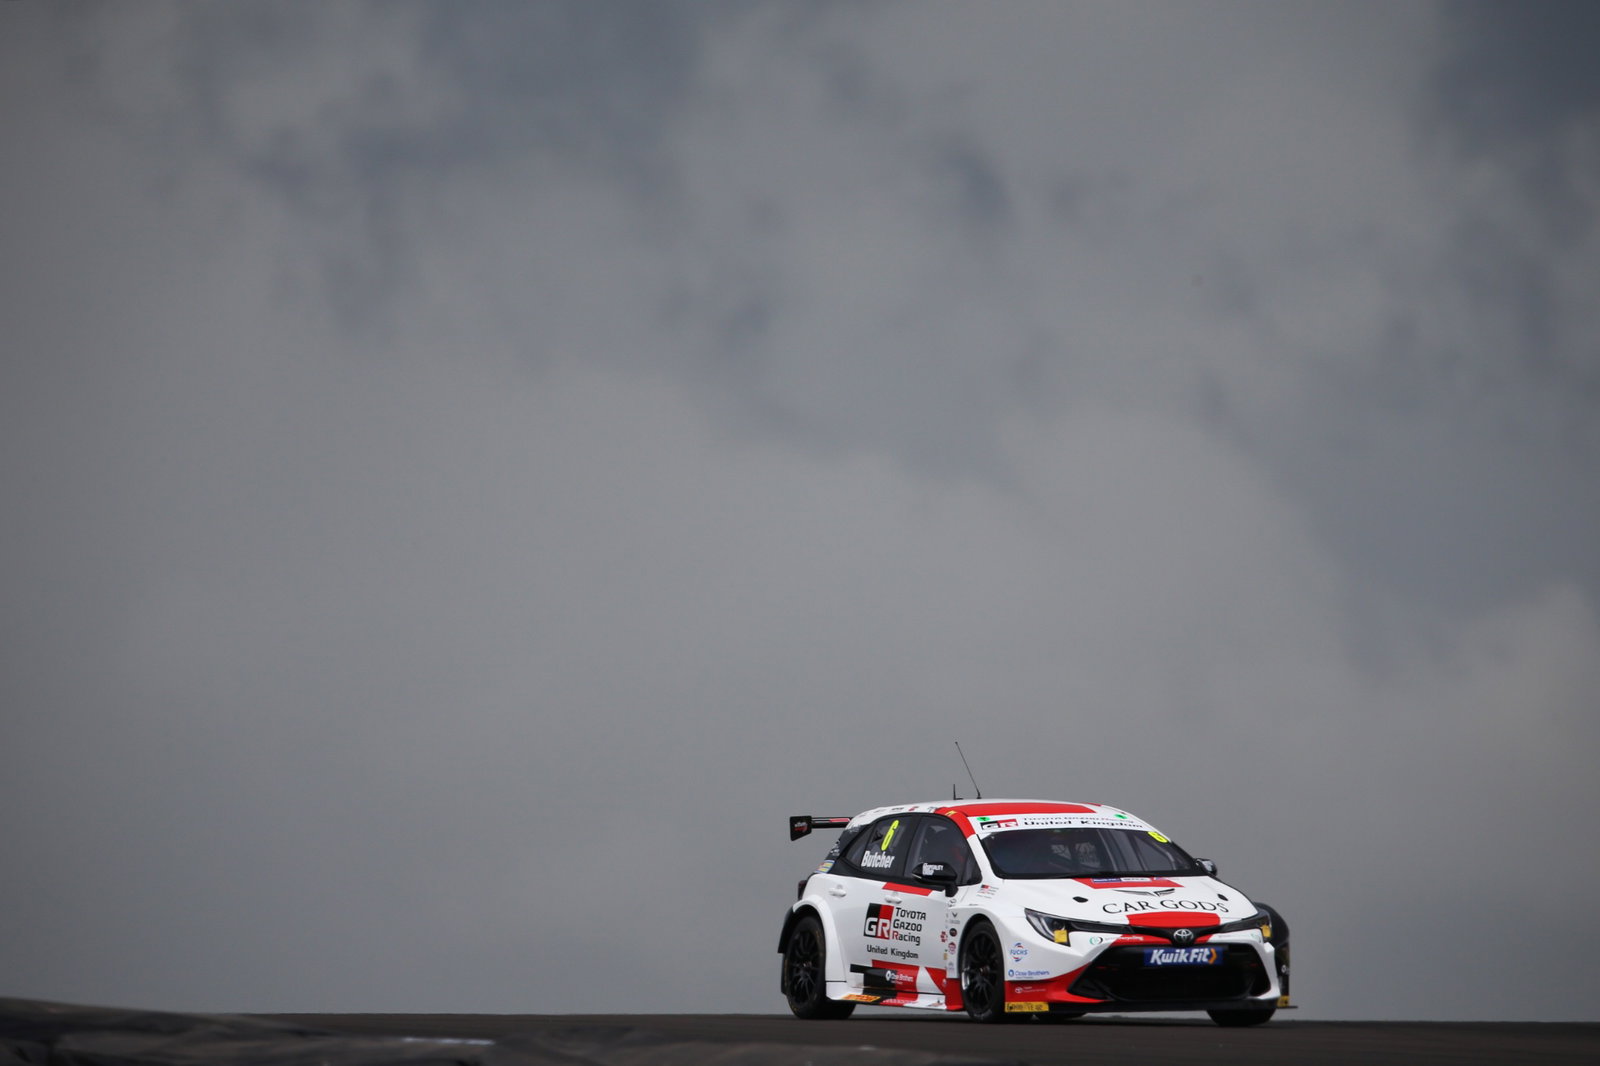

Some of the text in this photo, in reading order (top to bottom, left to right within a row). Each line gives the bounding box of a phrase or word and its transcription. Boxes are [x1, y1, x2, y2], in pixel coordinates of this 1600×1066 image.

[1080, 820, 1143, 828] Kingdom
[881, 819, 900, 851] 6
[861, 850, 895, 869] Butcher
[895, 907, 927, 921] TOYOTA
[1102, 899, 1229, 915] CAR GODS
[864, 917, 892, 939] GR
[893, 918, 922, 933] GAZOO
[892, 931, 921, 947] Racing
[867, 944, 919, 960] United Kingdom
